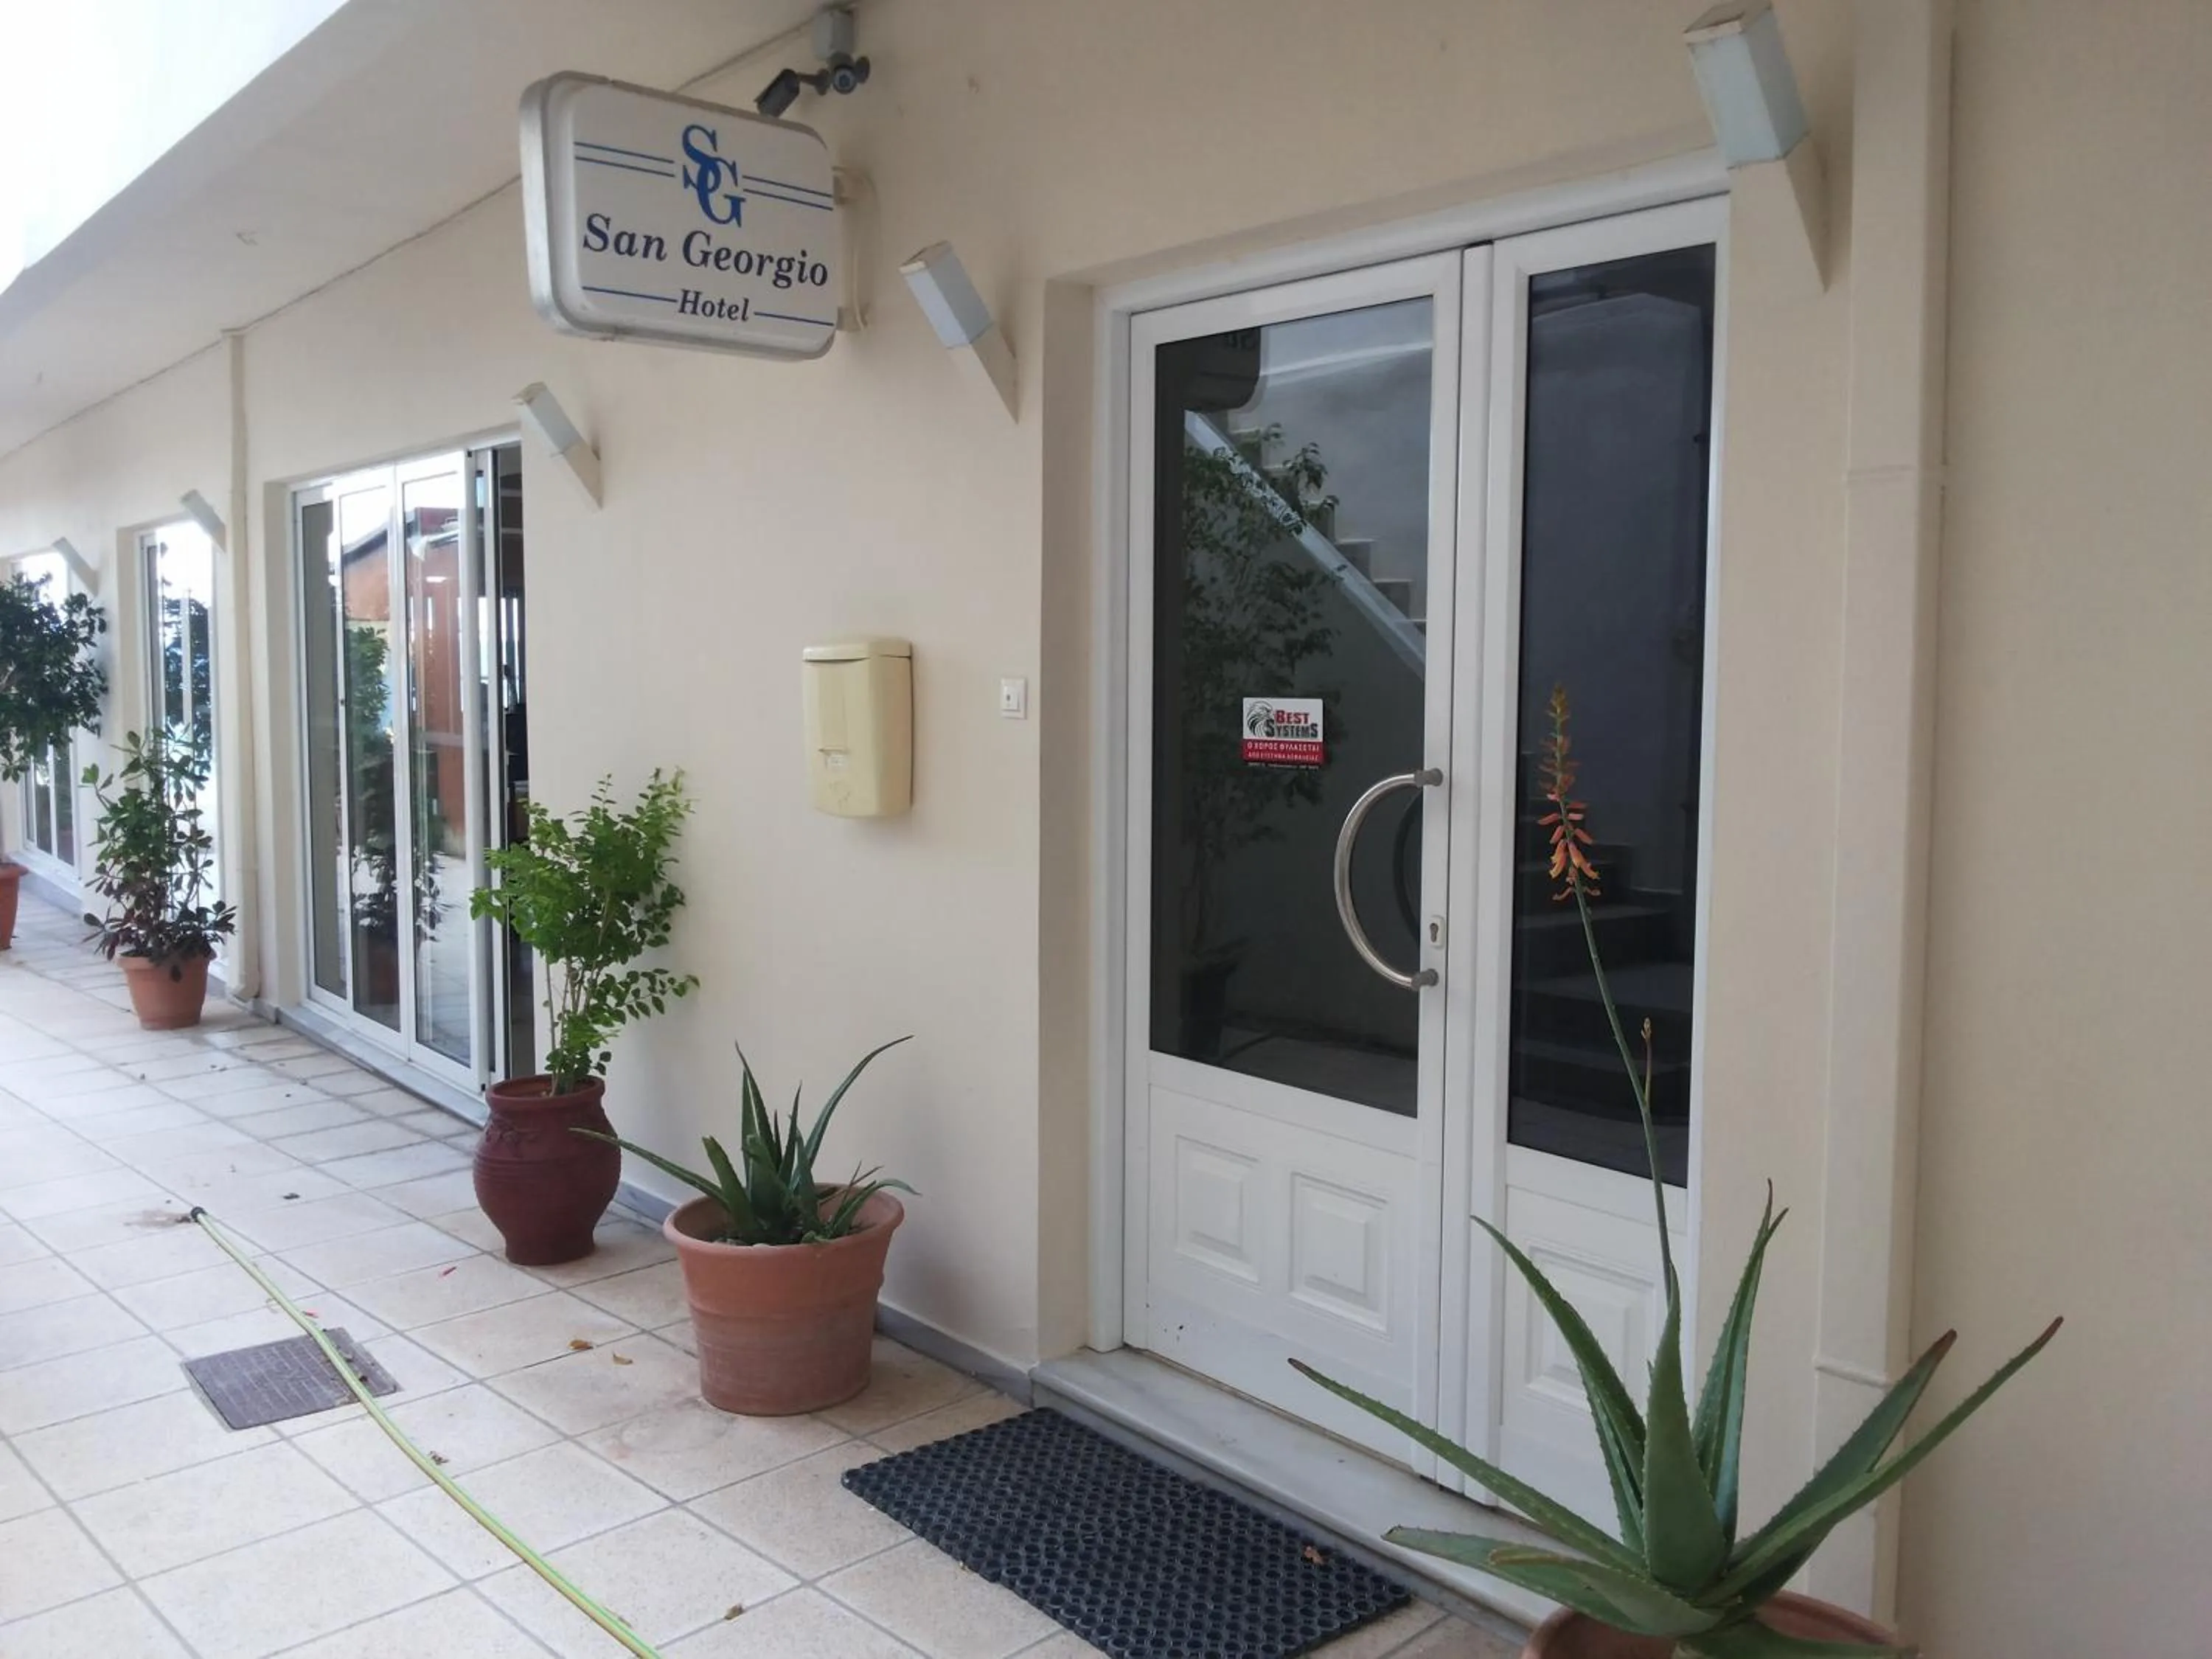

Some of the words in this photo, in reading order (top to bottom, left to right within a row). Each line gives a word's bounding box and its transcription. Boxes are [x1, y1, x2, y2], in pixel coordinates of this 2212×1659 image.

[582, 212, 667, 261] San
[682, 229, 828, 289] Georgio
[676, 288, 750, 321] Hotel
